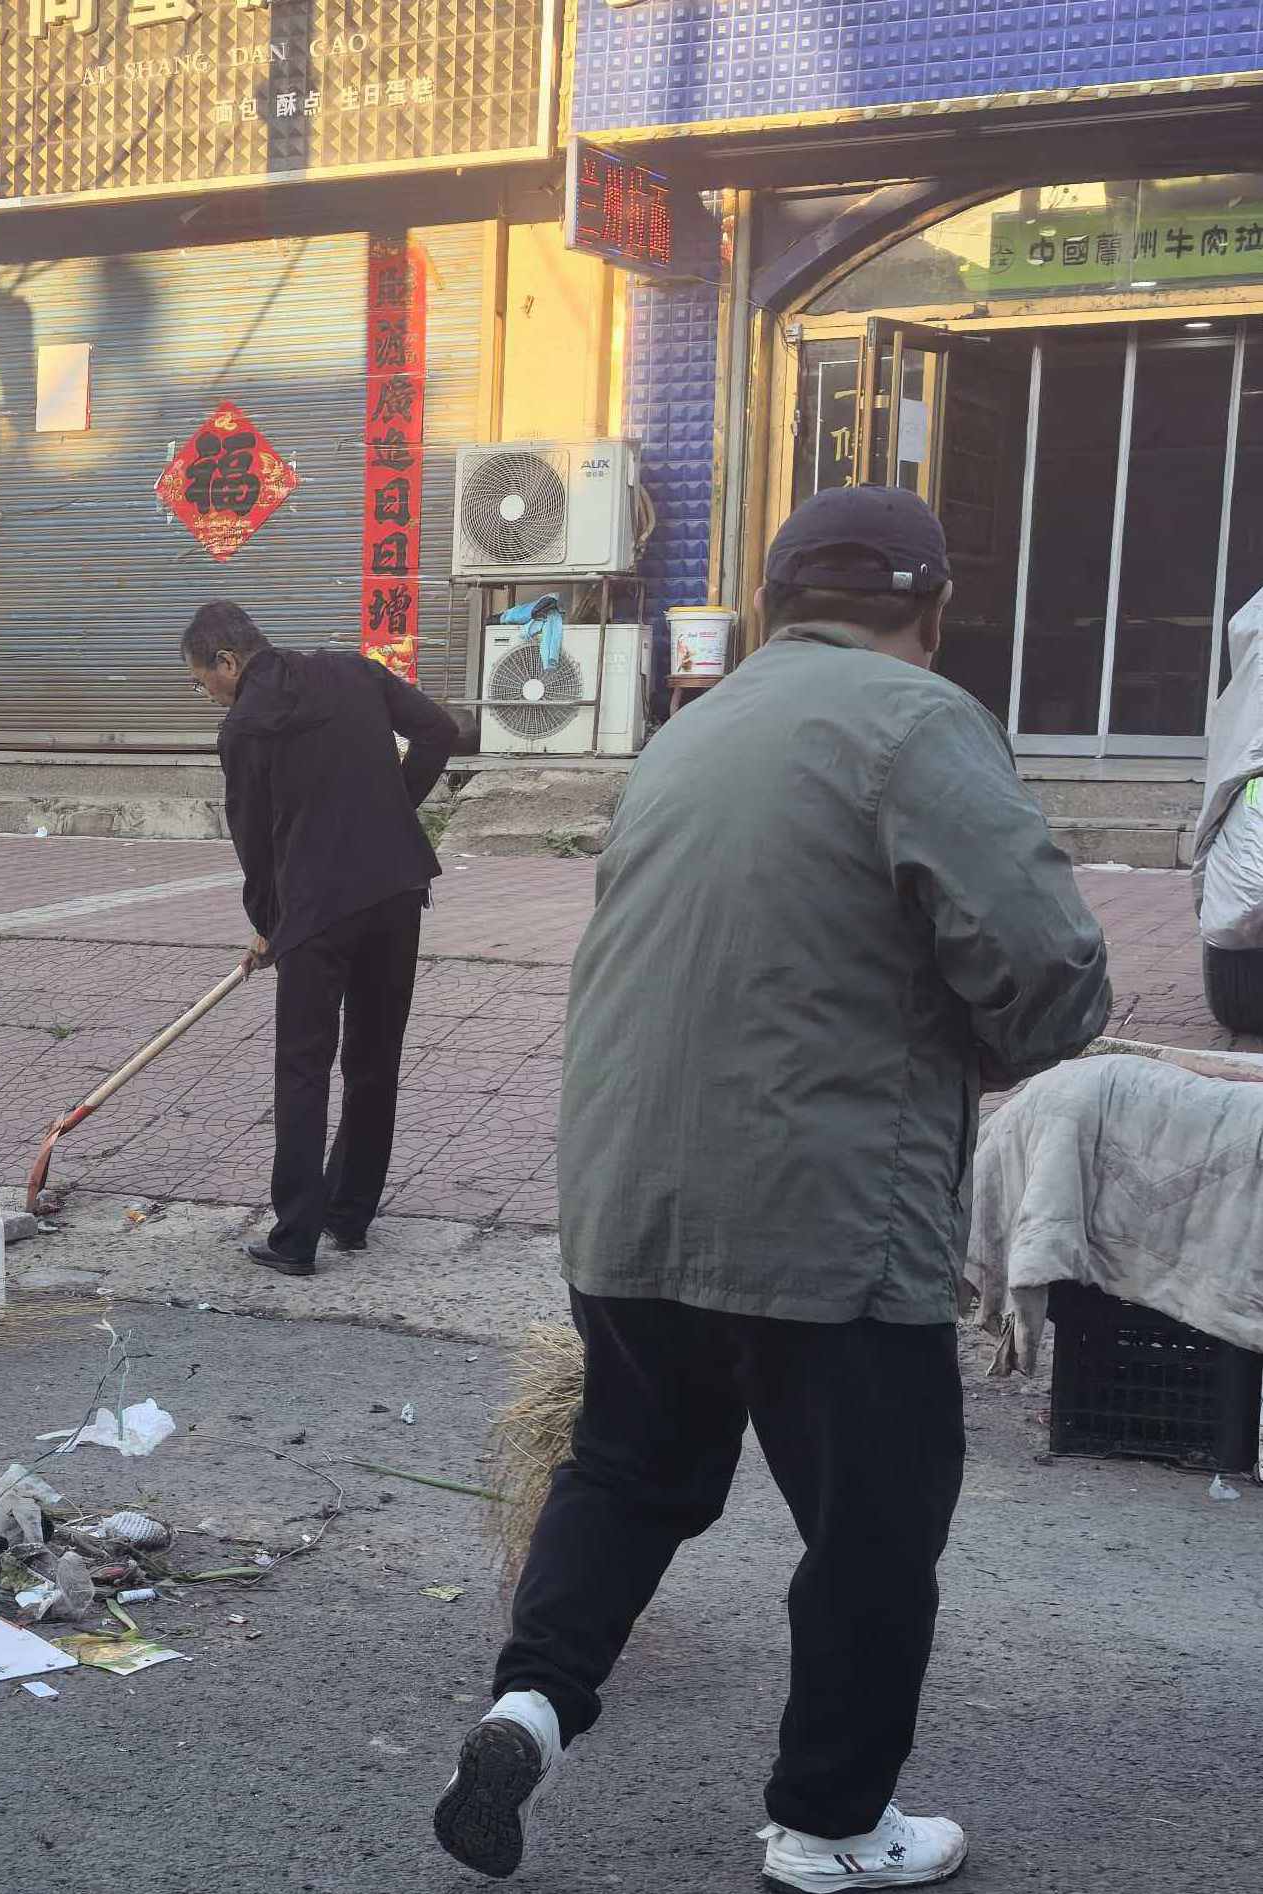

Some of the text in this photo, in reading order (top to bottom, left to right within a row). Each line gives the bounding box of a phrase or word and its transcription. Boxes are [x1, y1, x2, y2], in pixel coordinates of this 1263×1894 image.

[123, 48, 209, 81] SHANG
[230, 41, 290, 67] DAN
[213, 78, 436, 124] 面包 酥点 生日蛋糕
[185, 431, 262, 516] 福
[581, 459, 610, 469] AUX
